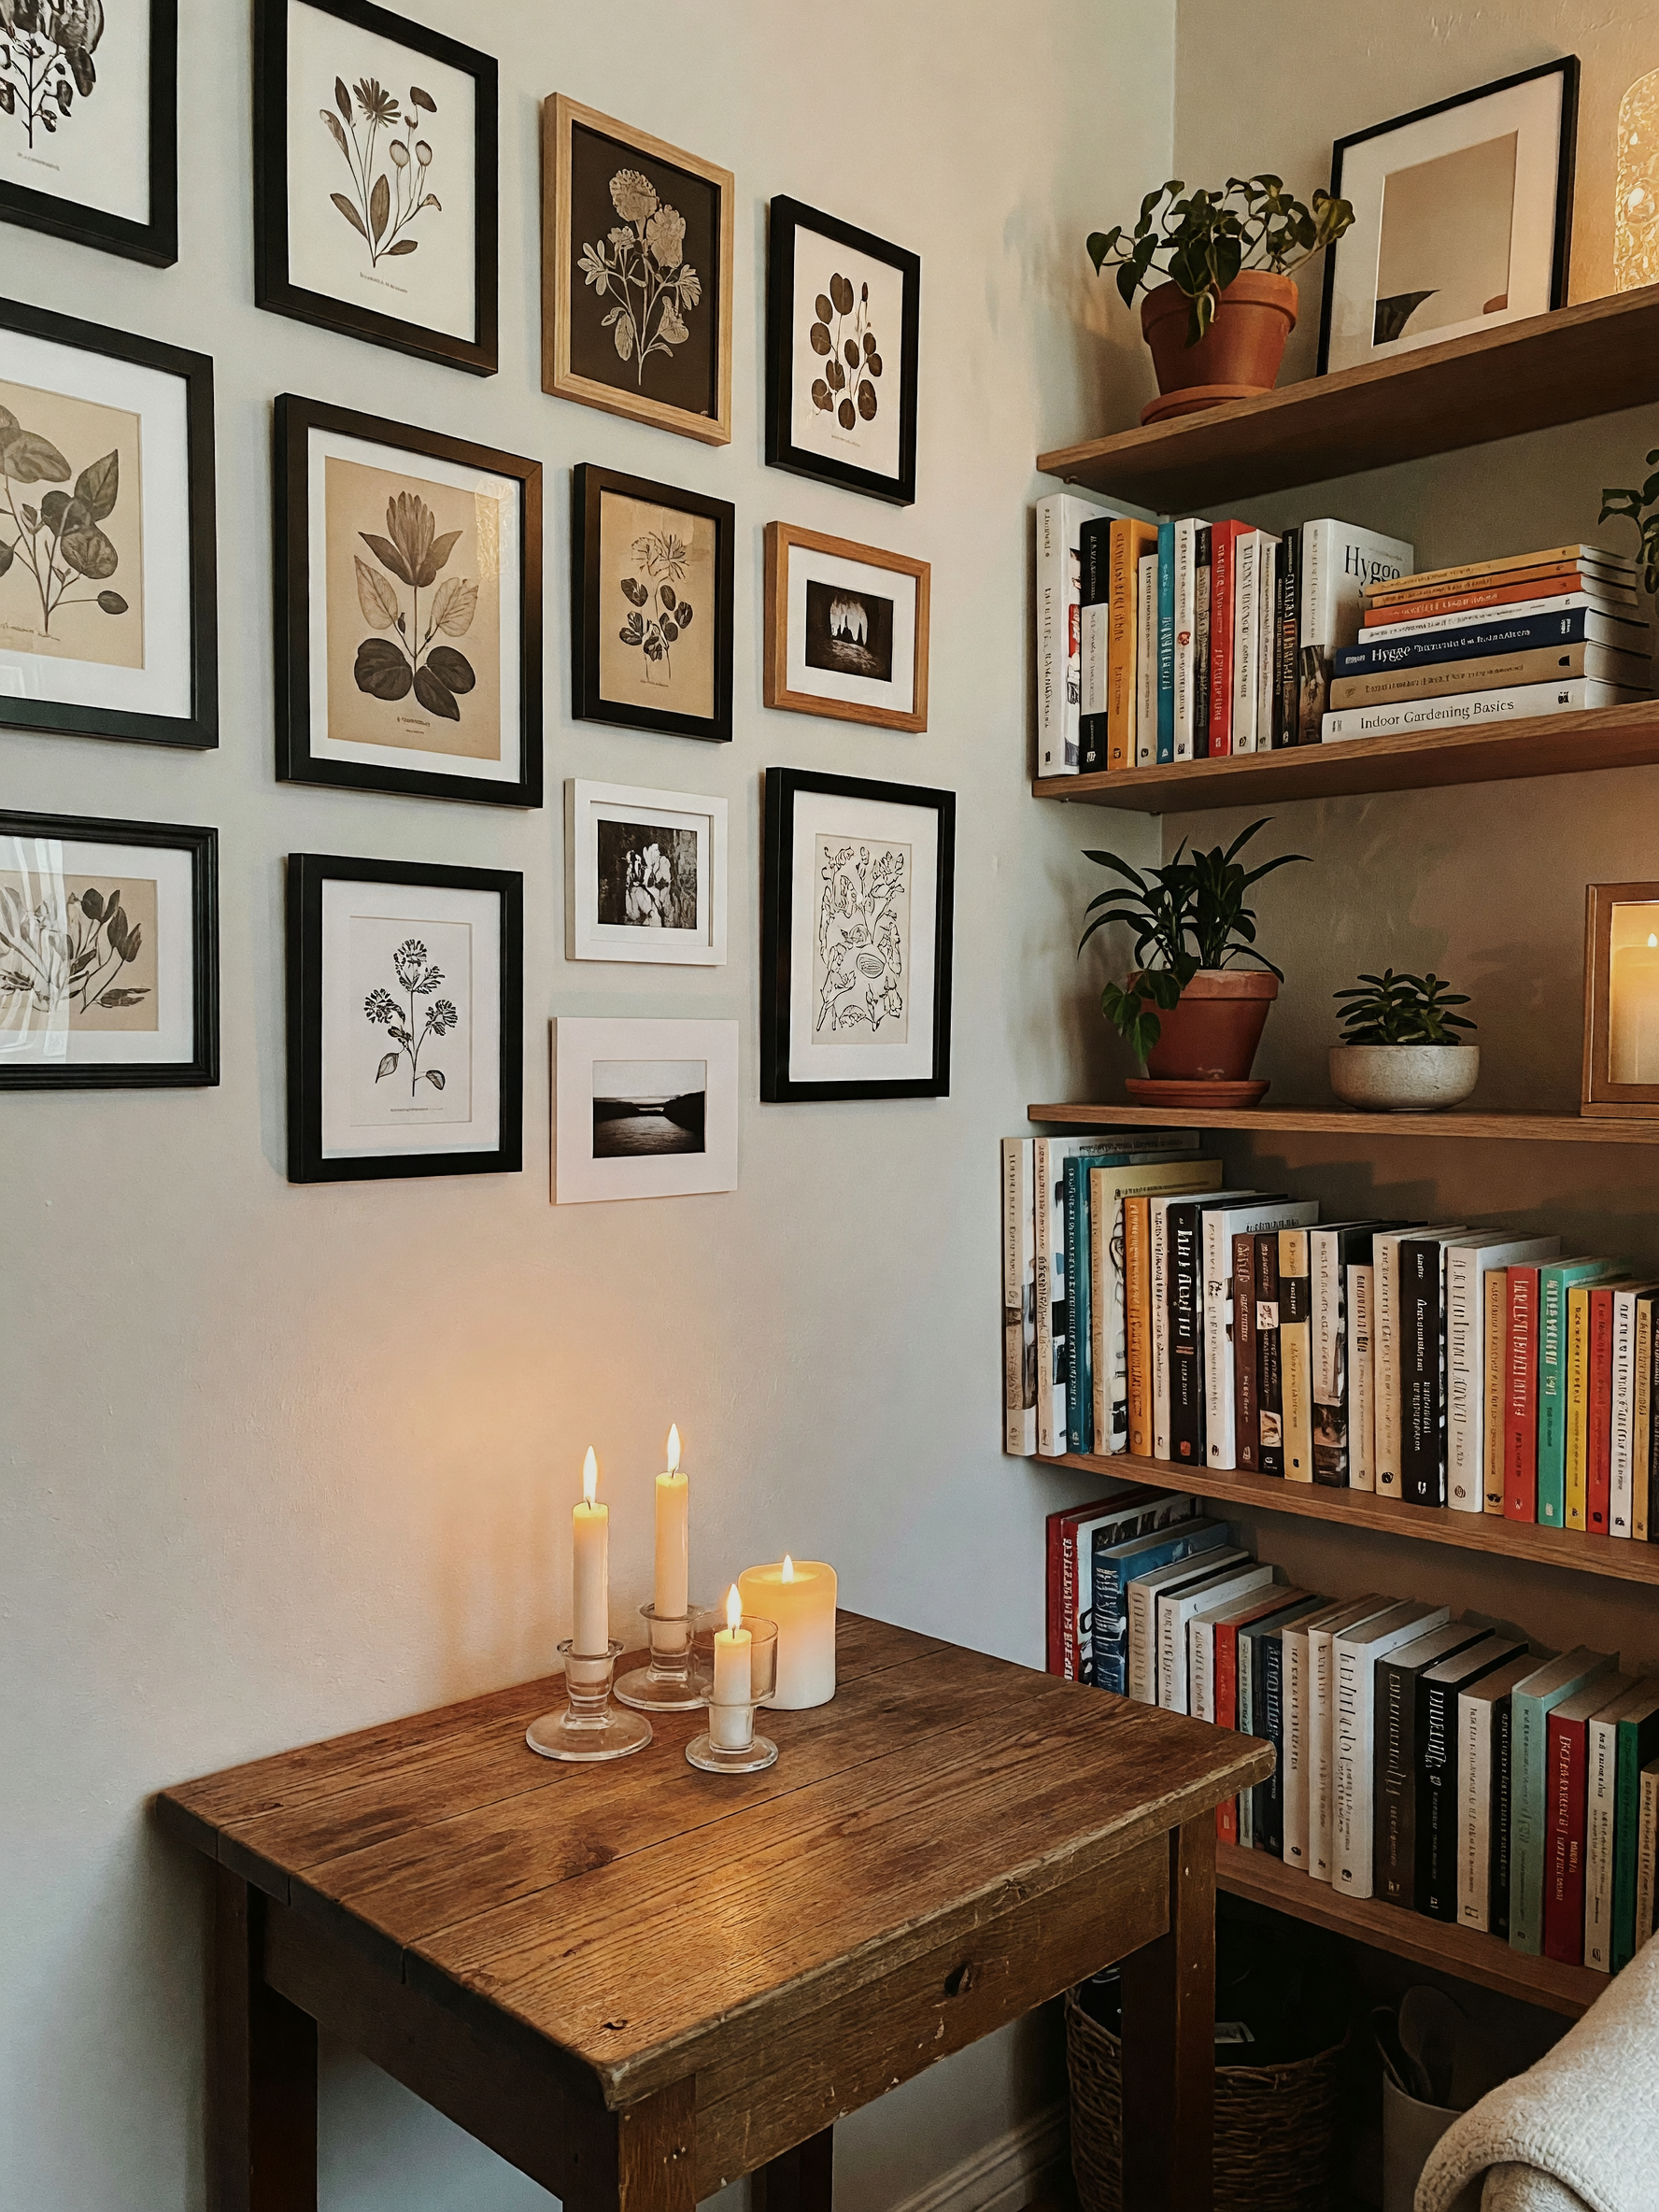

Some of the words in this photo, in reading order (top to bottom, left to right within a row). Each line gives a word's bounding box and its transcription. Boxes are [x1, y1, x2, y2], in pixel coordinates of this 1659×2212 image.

[1360, 716, 1400, 730] Indoor
[1403, 706, 1470, 724] Gardening
[1472, 700, 1514, 716] Basics
